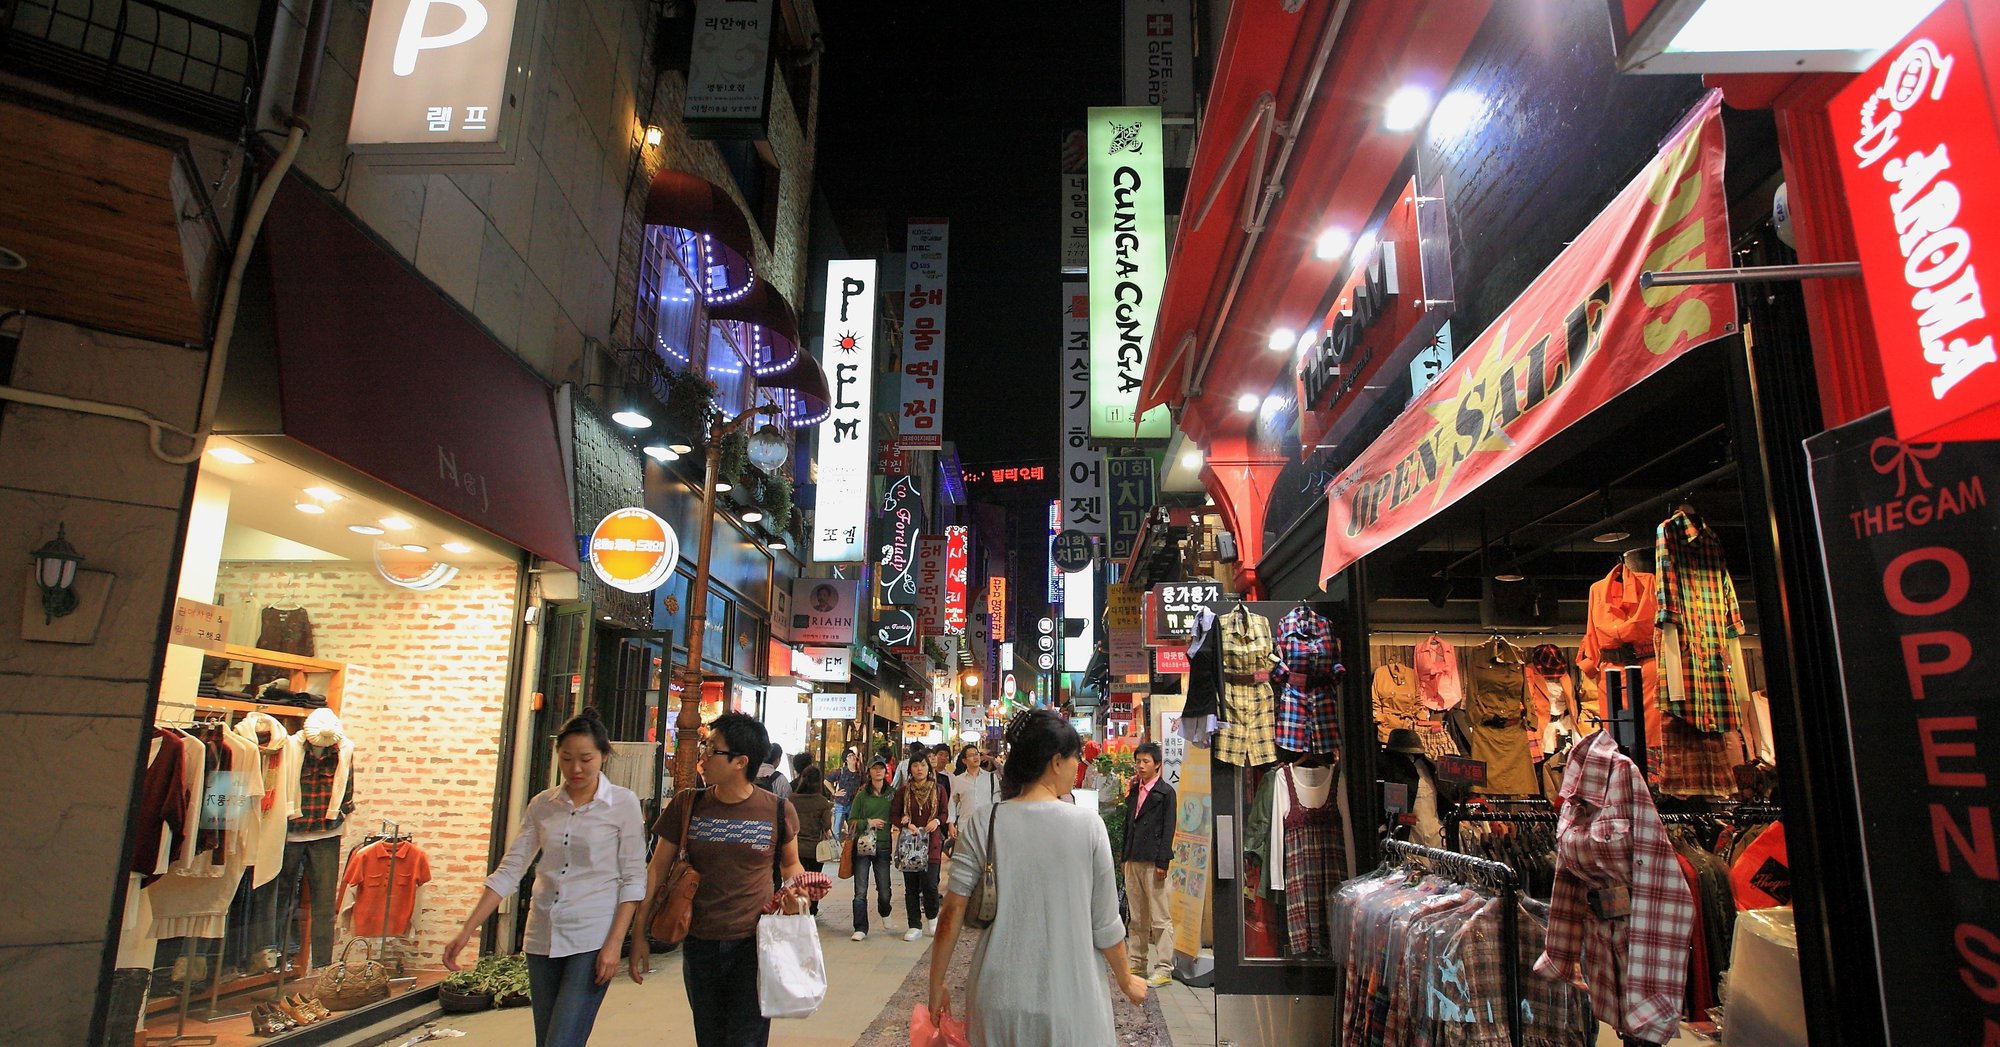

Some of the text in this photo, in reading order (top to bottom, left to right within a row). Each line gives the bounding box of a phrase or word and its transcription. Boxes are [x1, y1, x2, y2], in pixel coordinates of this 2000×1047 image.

[393, 0, 488, 76] P
[705, 17, 758, 30] 리안헤어
[1148, 41, 1160, 105] GUARD
[1161, 41, 1173, 79] LIFE
[426, 106, 488, 131] 램프
[1882, 142, 1998, 400] AROMA
[1301, 240, 1399, 411] THEGAM
[904, 284, 943, 429] 해물떡찜
[1344, 278, 1614, 537] OPEN SALE
[1111, 461, 1149, 477] 이화
[1849, 475, 1987, 540] THEGAM
[823, 526, 857, 544] 포엠
[890, 508, 911, 572] Forelady
[1056, 548, 1089, 562] 치과
[1057, 536, 1086, 547] 이화
[918, 540, 942, 625] 해물떡찜
[993, 579, 1001, 597] DVD
[197, 629, 222, 641] 구해요
[811, 617, 851, 627] RIAHN
[1882, 546, 2000, 881] OPEN
